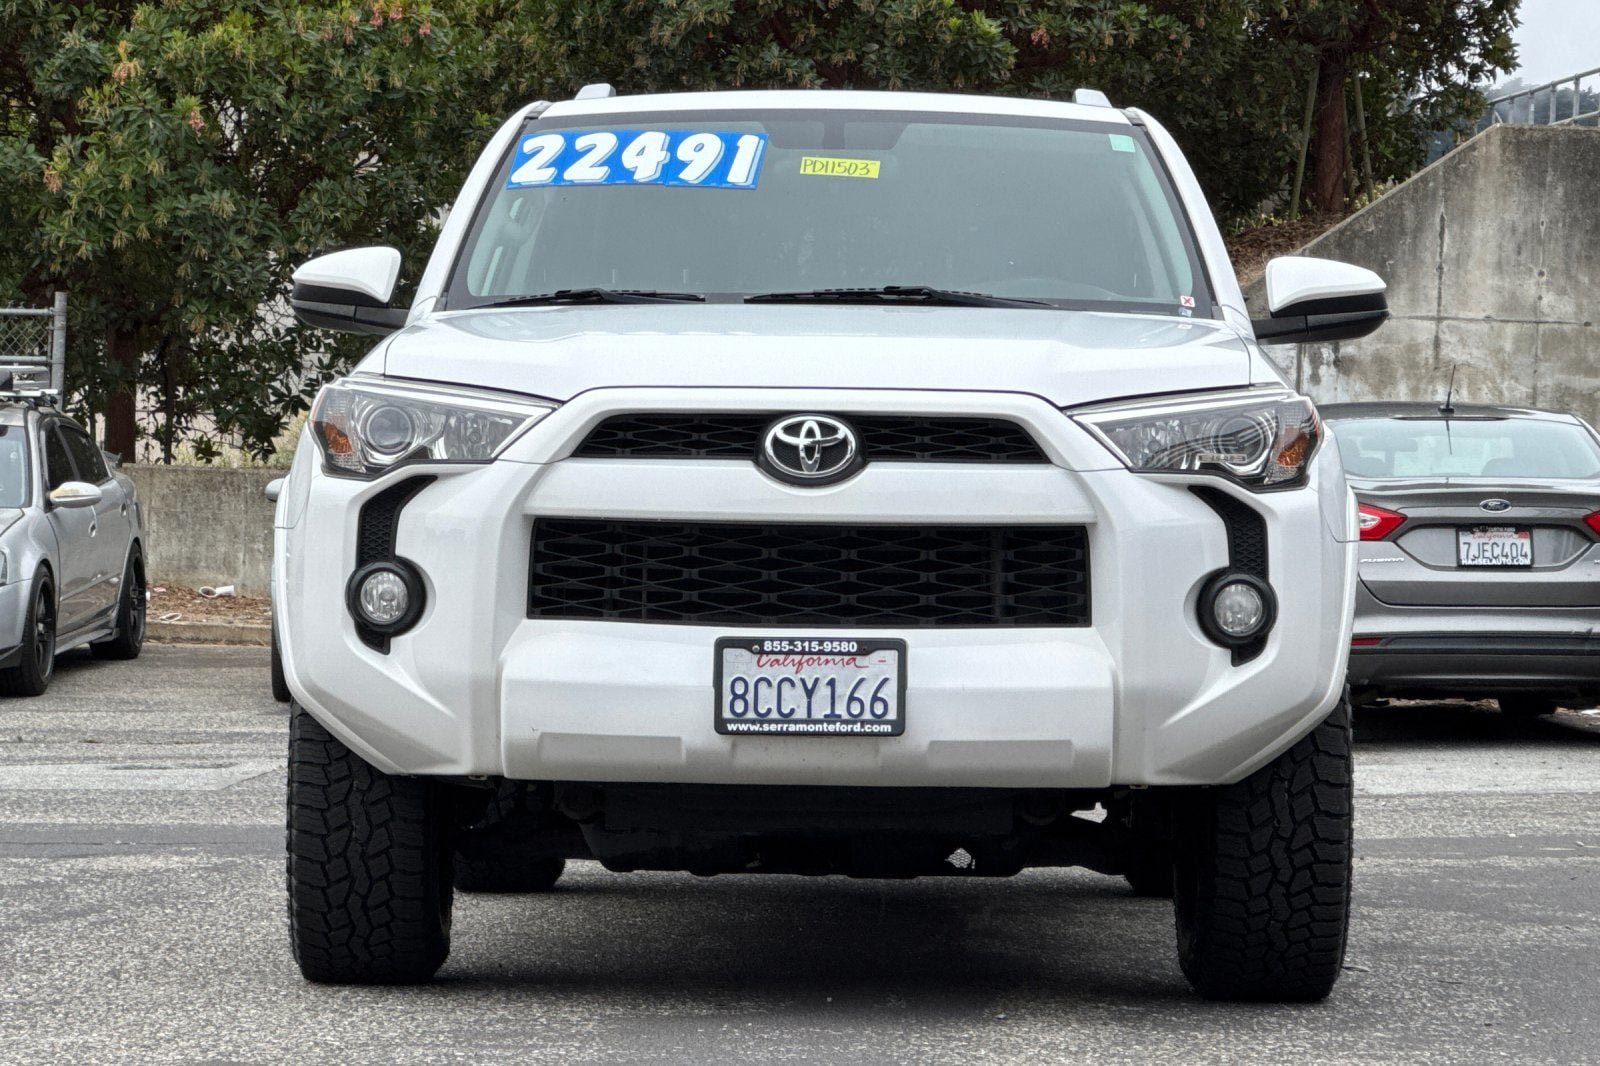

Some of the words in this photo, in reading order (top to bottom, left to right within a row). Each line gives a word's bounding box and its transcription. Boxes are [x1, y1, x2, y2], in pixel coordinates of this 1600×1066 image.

[510, 130, 766, 185] 22491
[1463, 542, 1528, 559] 7JEC404
[763, 641, 858, 652] 855-315-9580
[756, 654, 869, 674] California
[729, 676, 890, 719] 8CCY166
[727, 722, 892, 733] www.serramonteford.com
